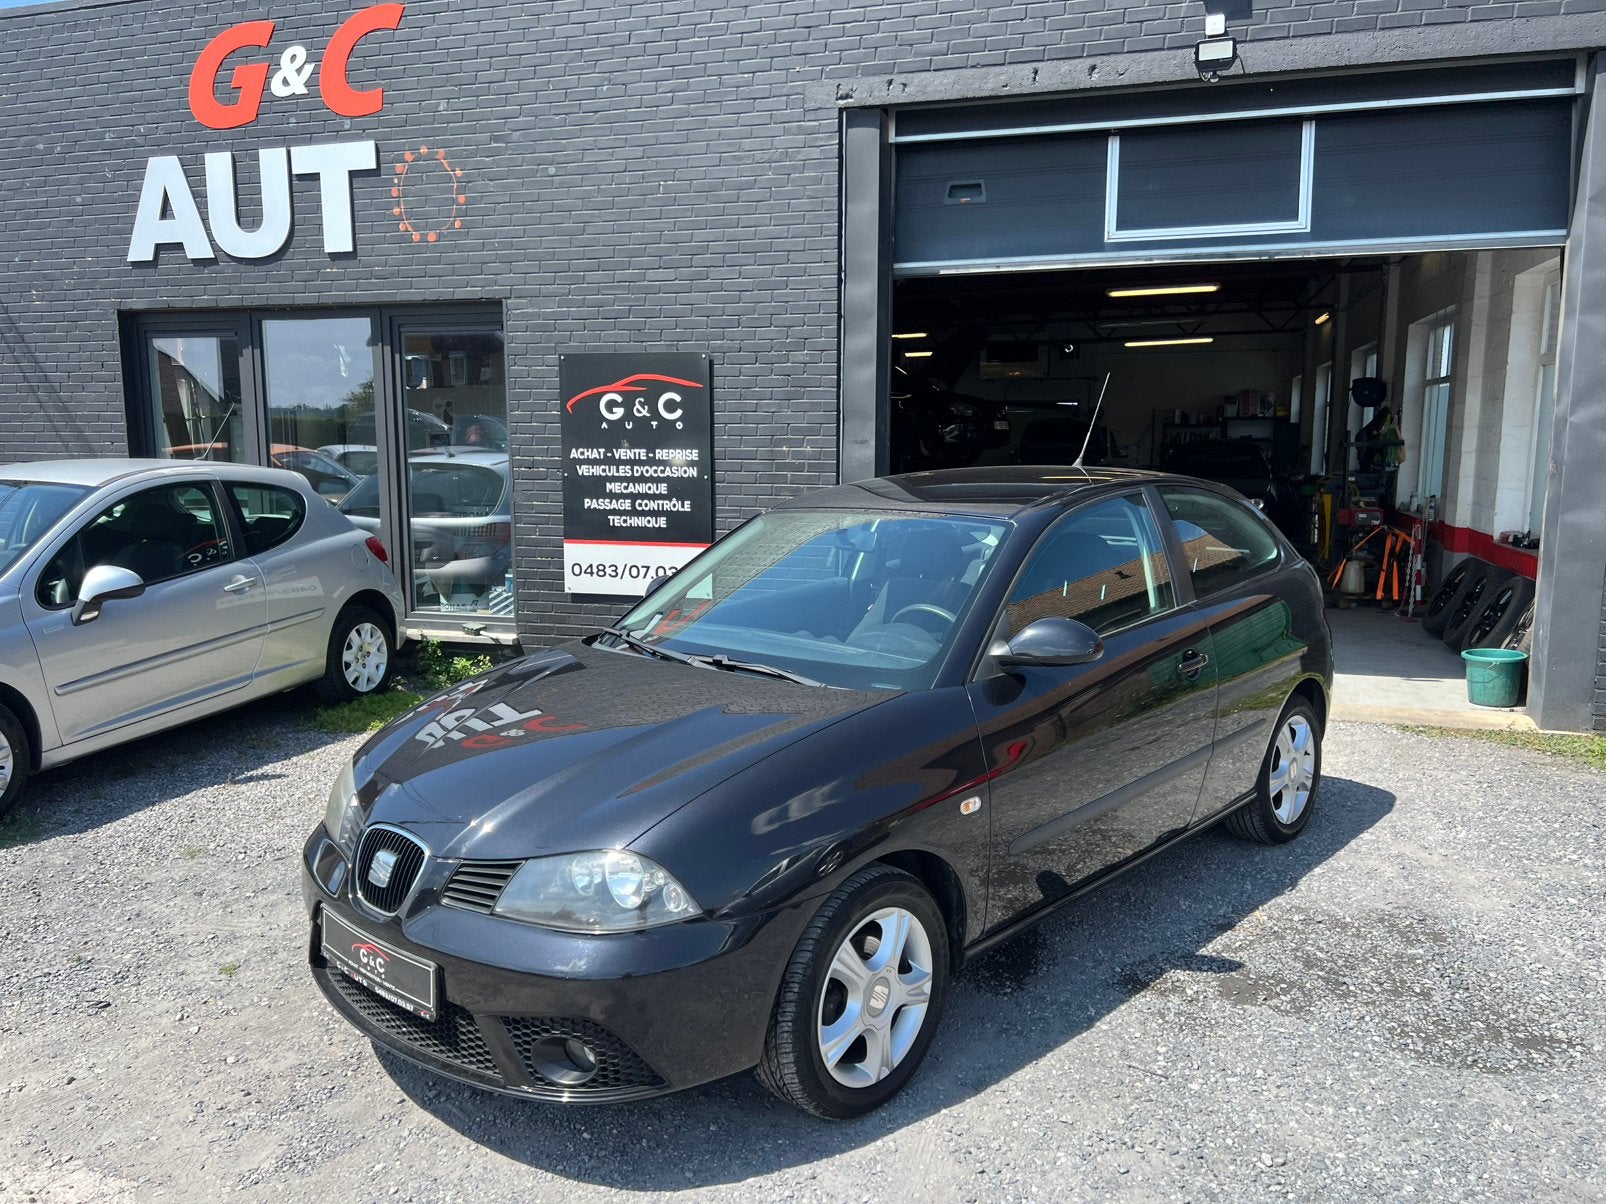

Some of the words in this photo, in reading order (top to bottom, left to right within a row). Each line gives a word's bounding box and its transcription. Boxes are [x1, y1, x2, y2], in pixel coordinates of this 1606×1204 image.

[570, 448, 606, 460] ACHAT
[613, 449, 647, 460] VENTE
[655, 449, 699, 461] REPRISE
[576, 465, 632, 477] VEHICULES
[633, 466, 697, 478] D'OCCASION
[606, 482, 668, 494] MECANIQUE
[584, 498, 632, 511] PASSAGE
[635, 498, 691, 512] CONTRÔLE
[607, 515, 667, 528] TECHNIQUE
